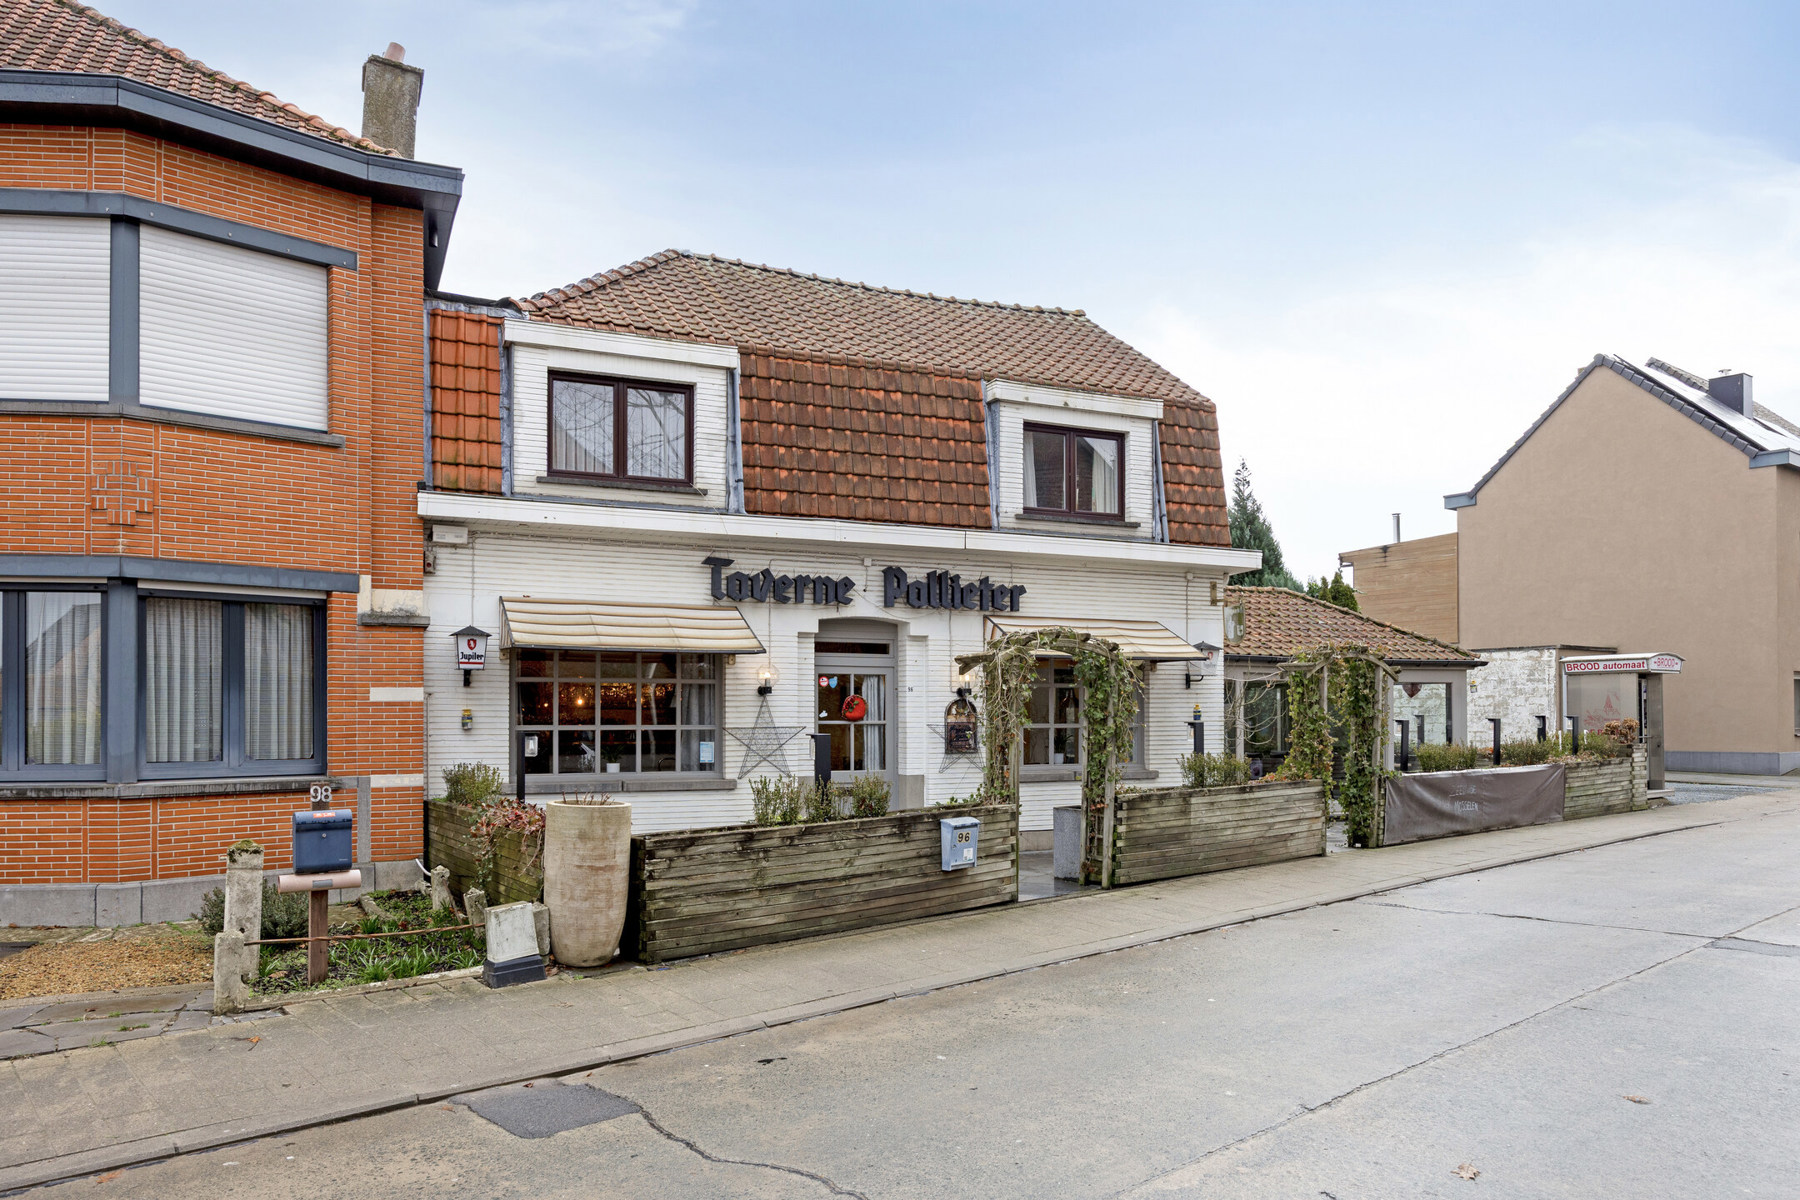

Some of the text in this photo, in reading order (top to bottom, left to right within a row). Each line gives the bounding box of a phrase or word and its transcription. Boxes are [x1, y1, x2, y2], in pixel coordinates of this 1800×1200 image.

[701, 556, 1027, 613] Taverne Pallieter
[460, 651, 484, 662] Jupiler
[1566, 661, 1645, 672] BROOD automaat
[310, 786, 332, 803] 98
[957, 832, 971, 843] 96
